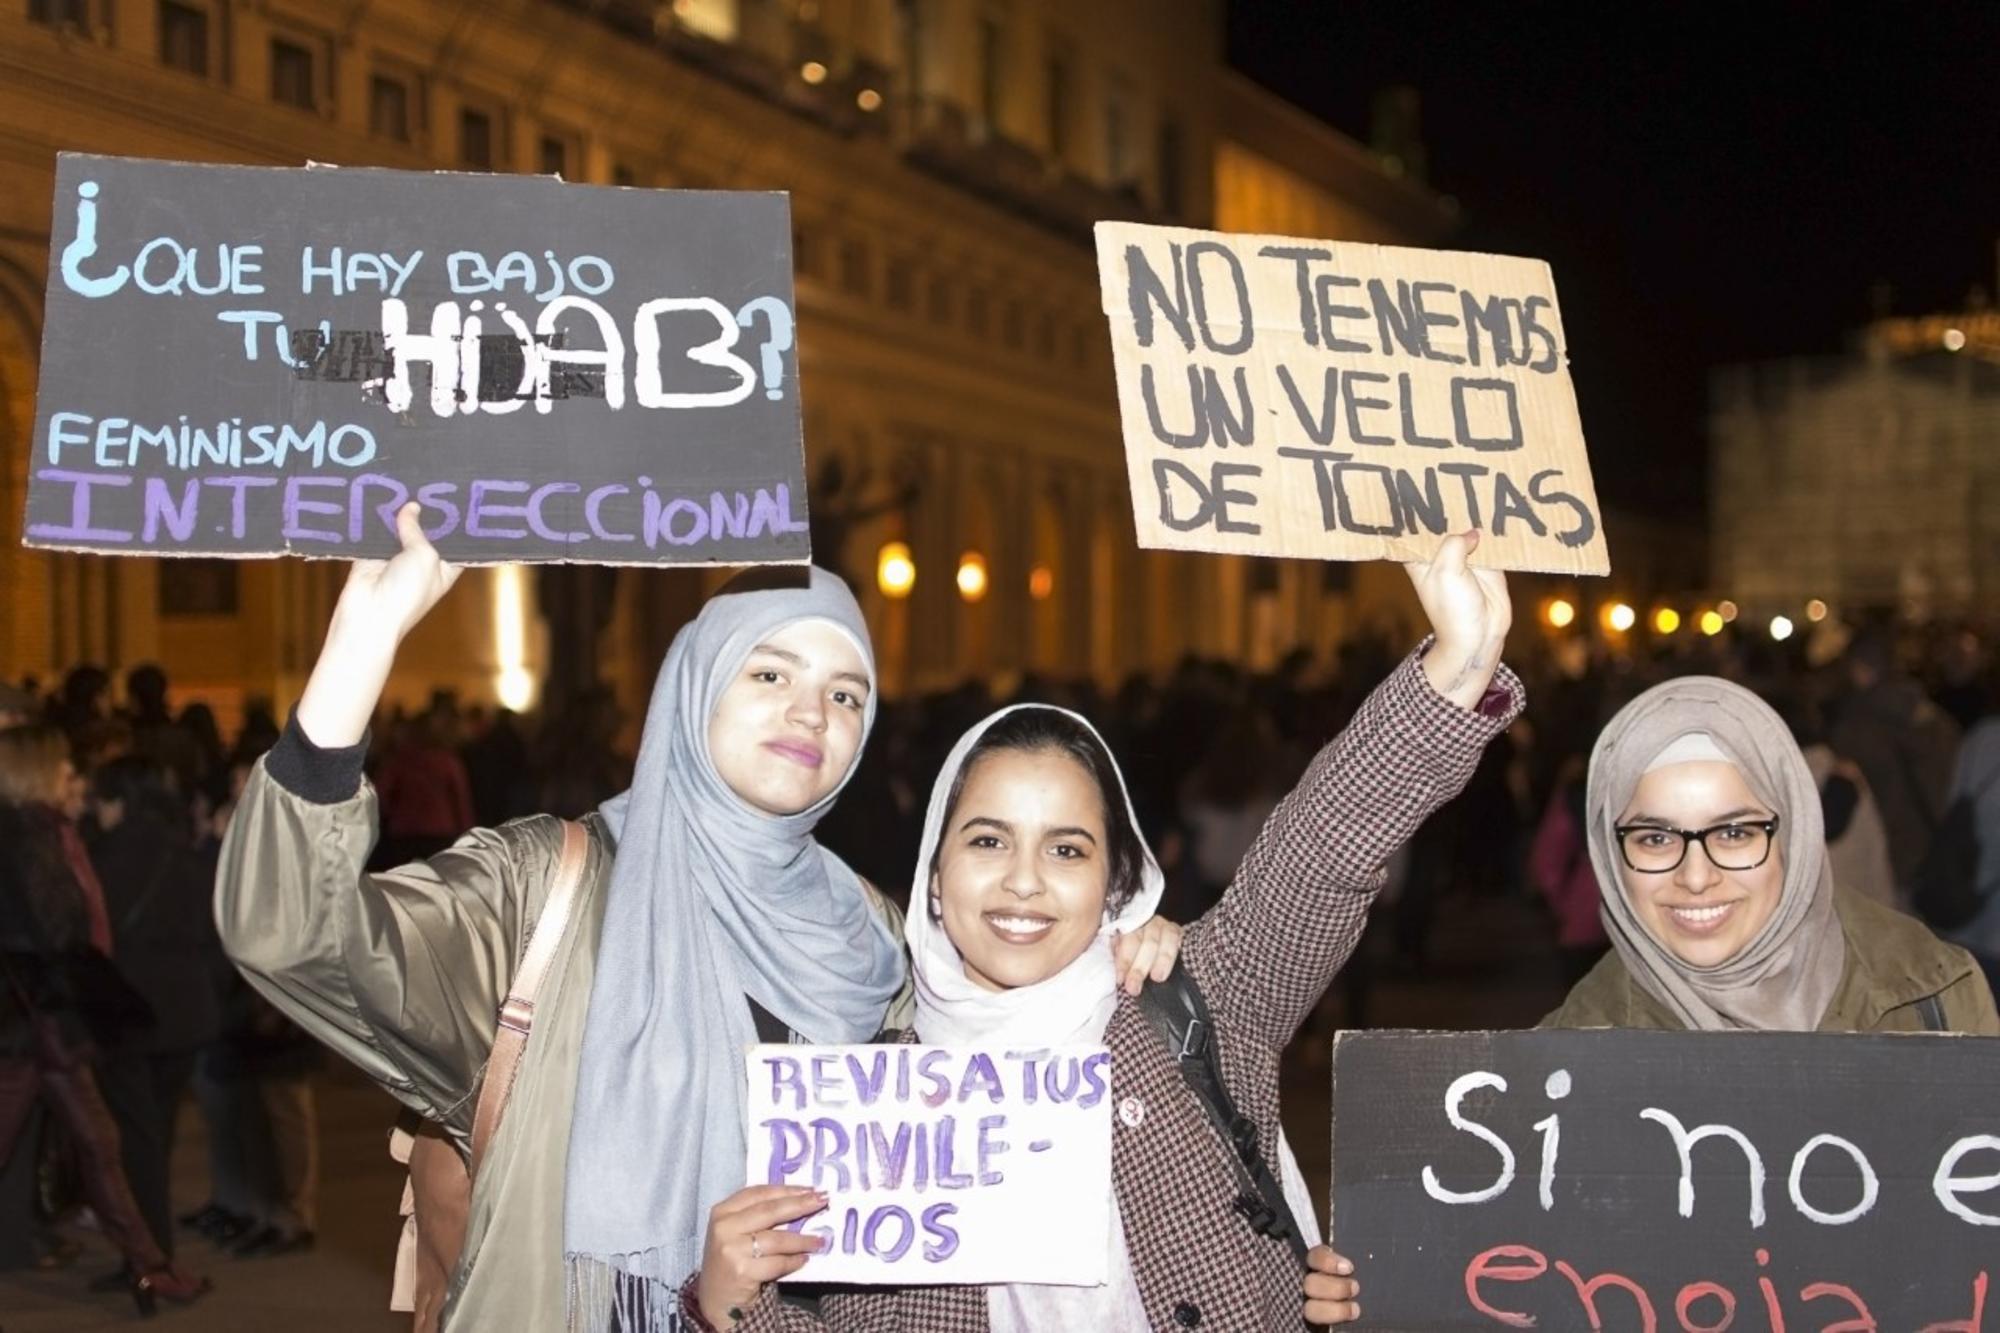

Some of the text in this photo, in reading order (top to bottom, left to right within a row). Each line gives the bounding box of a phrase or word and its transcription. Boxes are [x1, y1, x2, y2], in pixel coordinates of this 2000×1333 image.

[303, 247, 424, 296] HAY
[1125, 240, 1559, 374] NO TENEMOS
[1141, 363, 1523, 451] UN VELO
[1152, 446, 1596, 549] DE TONTAS
[1422, 1069, 1572, 1211] Si
[1640, 1107, 1879, 1228] no
